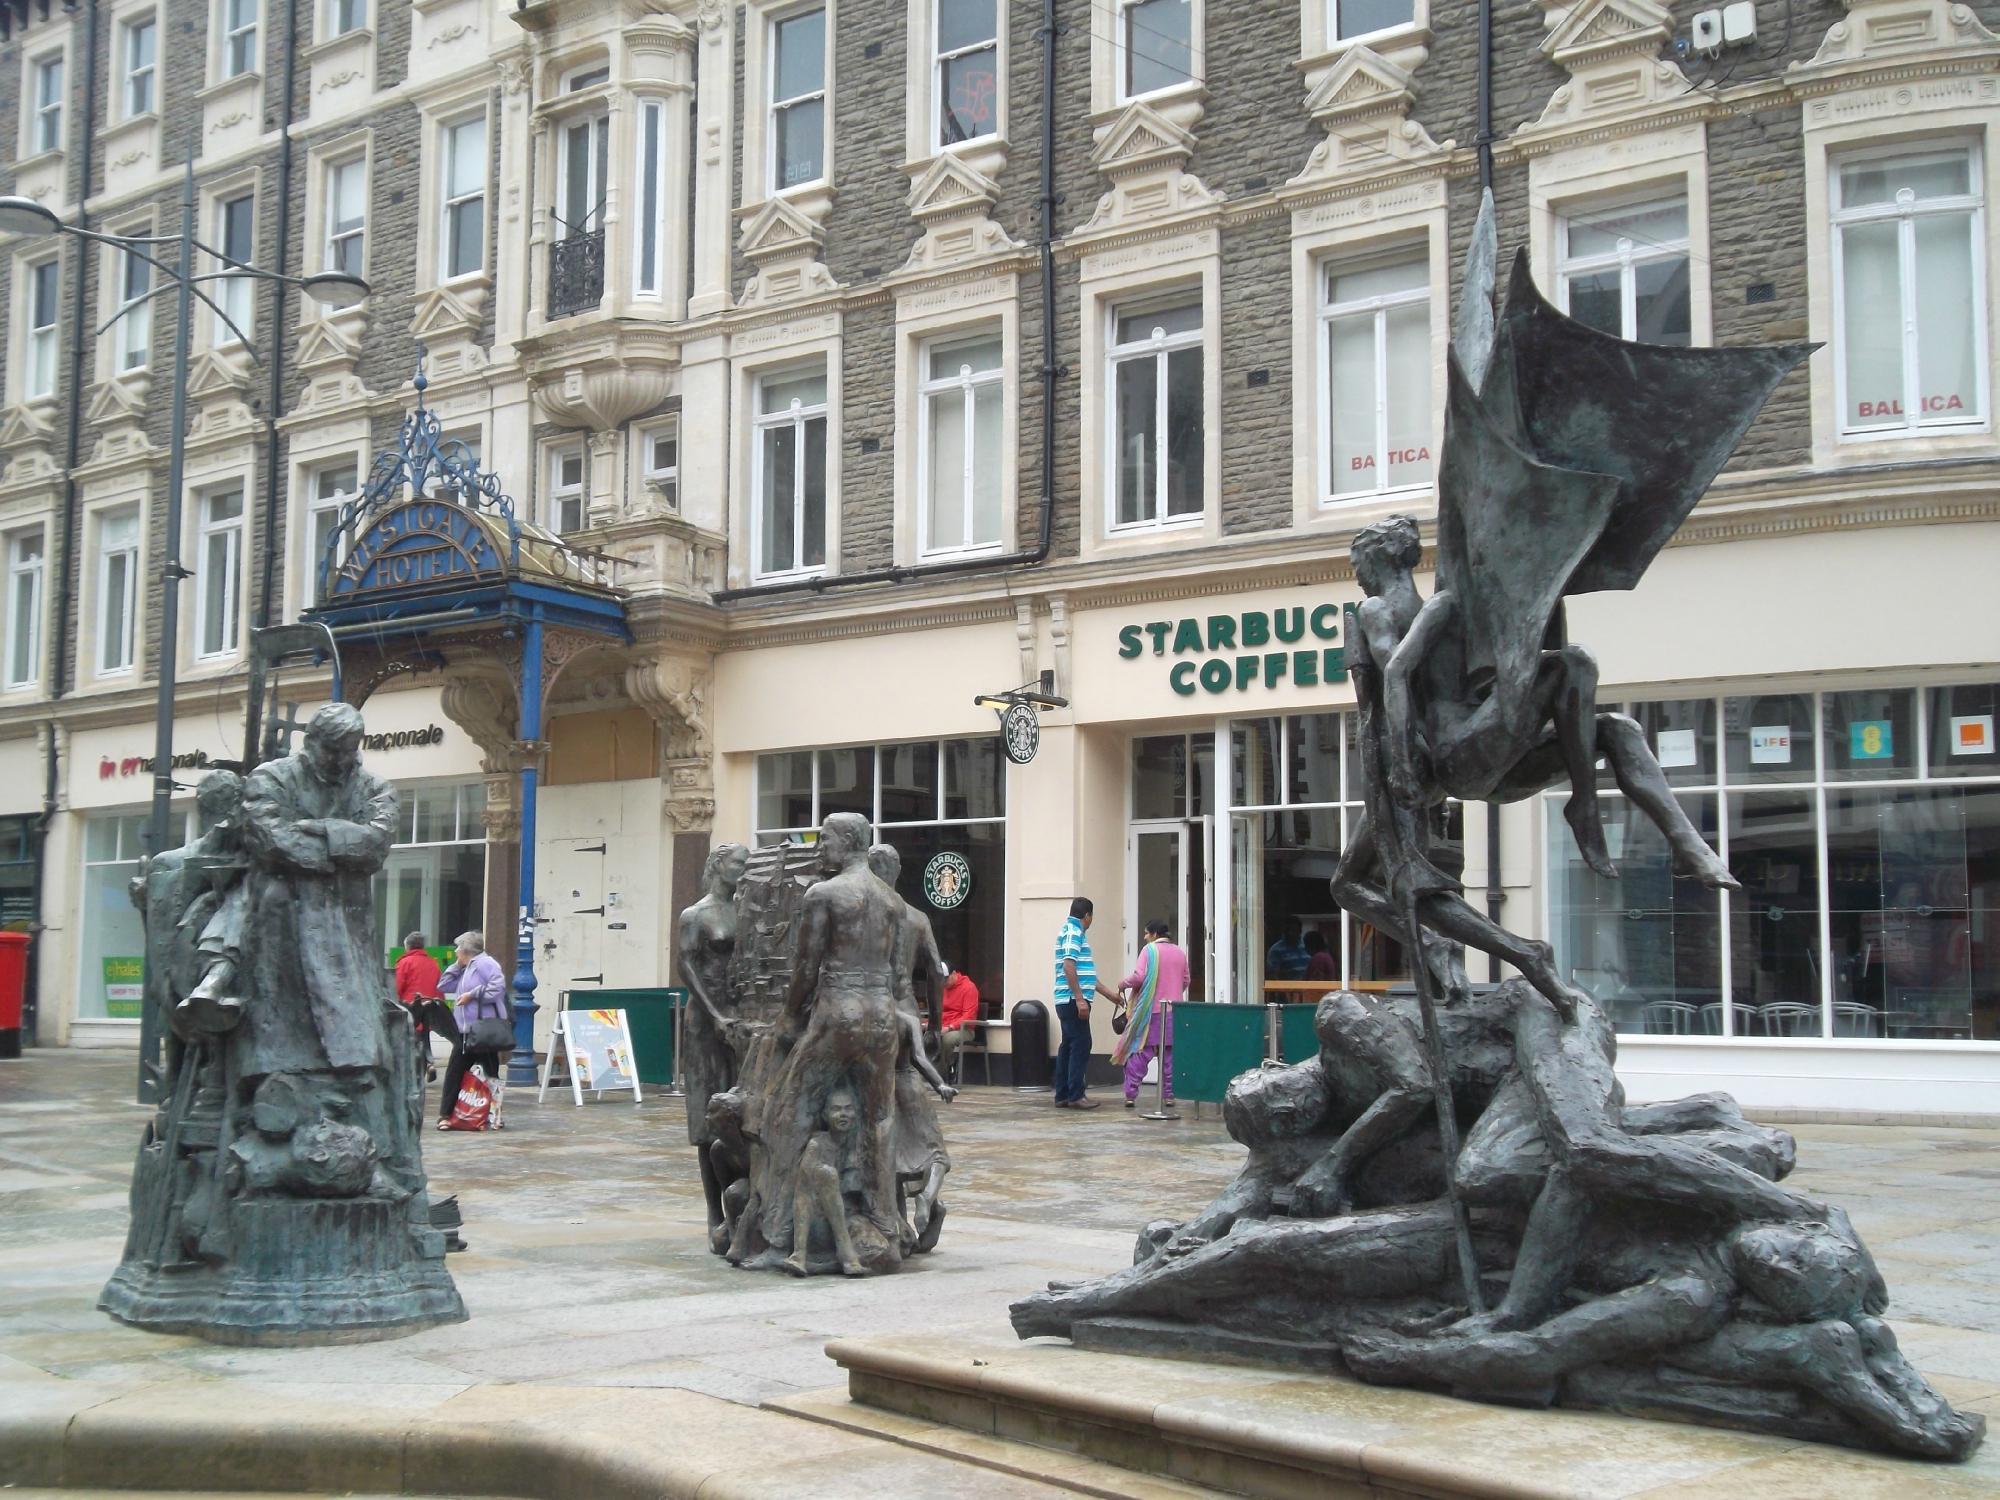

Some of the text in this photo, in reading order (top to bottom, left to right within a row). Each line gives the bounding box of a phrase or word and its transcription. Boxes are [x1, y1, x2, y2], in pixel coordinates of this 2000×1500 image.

[1858, 394, 1964, 418] BALICA
[1351, 447, 1430, 471] BATICA
[376, 546, 465, 587] HOTEL
[1118, 602, 1362, 658] STARBUC
[1169, 647, 1349, 695] COFFEE
[1008, 707, 1037, 734] STARBUCKS
[1753, 737, 1789, 748] LIFE
[926, 854, 968, 880] STARBUCKS
[930, 891, 962, 906] COFFEE
